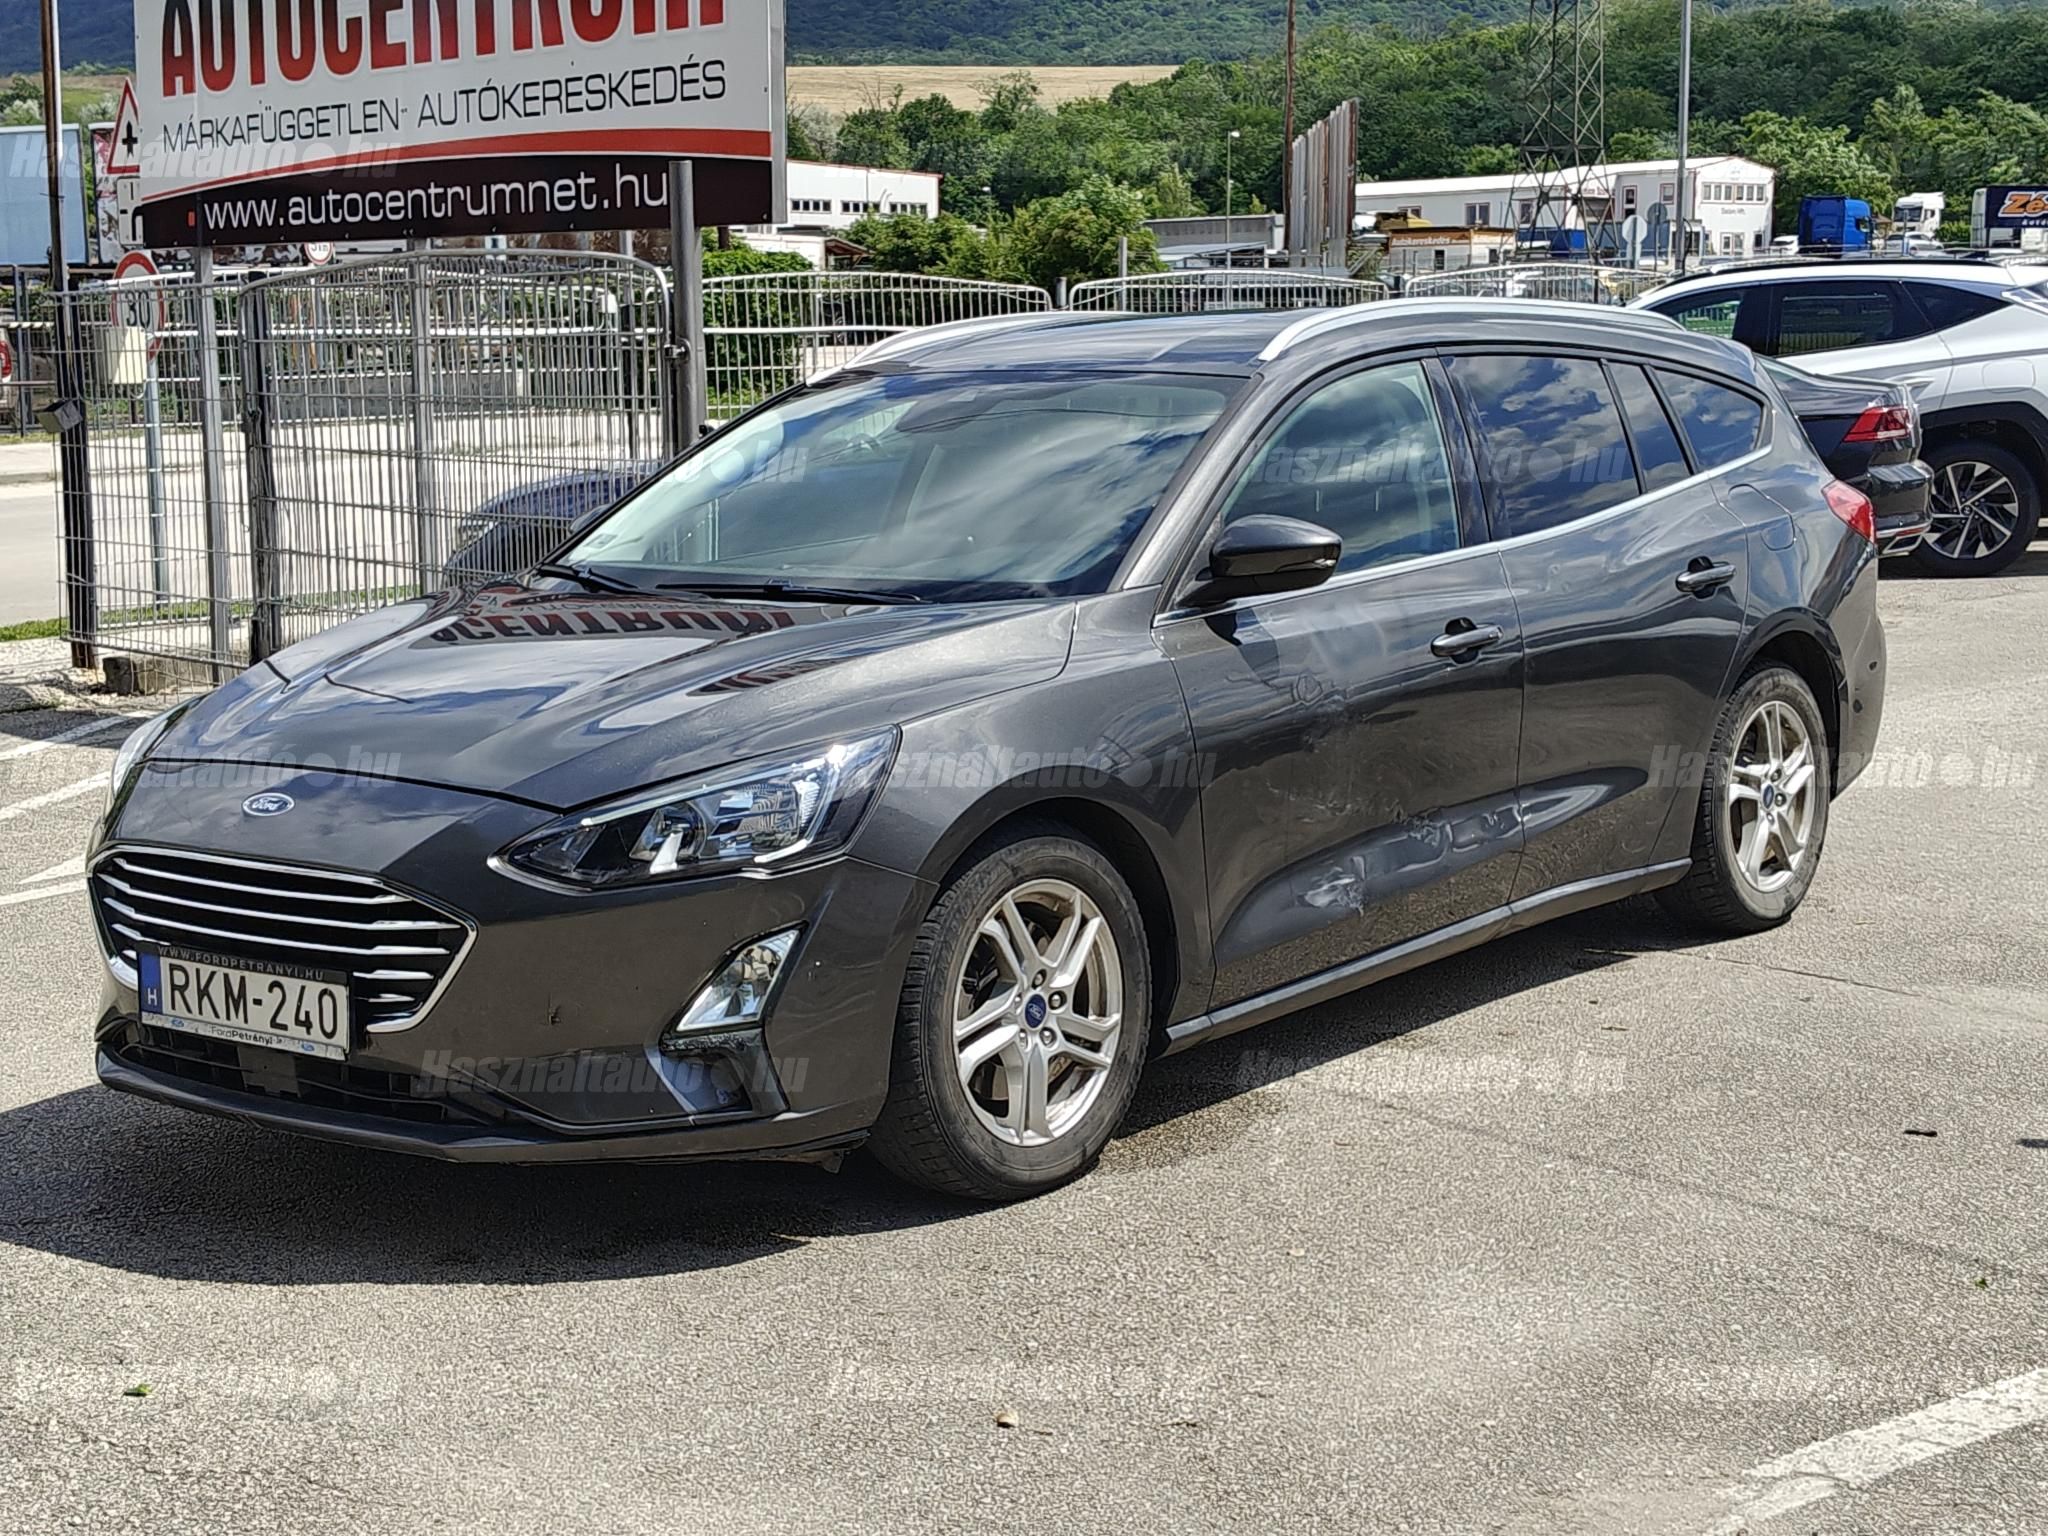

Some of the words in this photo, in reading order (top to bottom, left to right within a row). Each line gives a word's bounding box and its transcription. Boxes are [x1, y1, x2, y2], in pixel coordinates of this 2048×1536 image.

[162, 0, 724, 97] AUTOCE
[163, 98, 398, 152] MÁRKAFÜGGETLEN
[418, 54, 726, 128] AUTÓKERESKEDÉS
[204, 163, 667, 229] www.autocentrumnet.hu
[1999, 191, 2048, 216] Zé
[125, 290, 150, 328] 30
[249, 796, 289, 812] Ford
[147, 987, 158, 1006] H
[168, 962, 338, 1040] RKM-240
